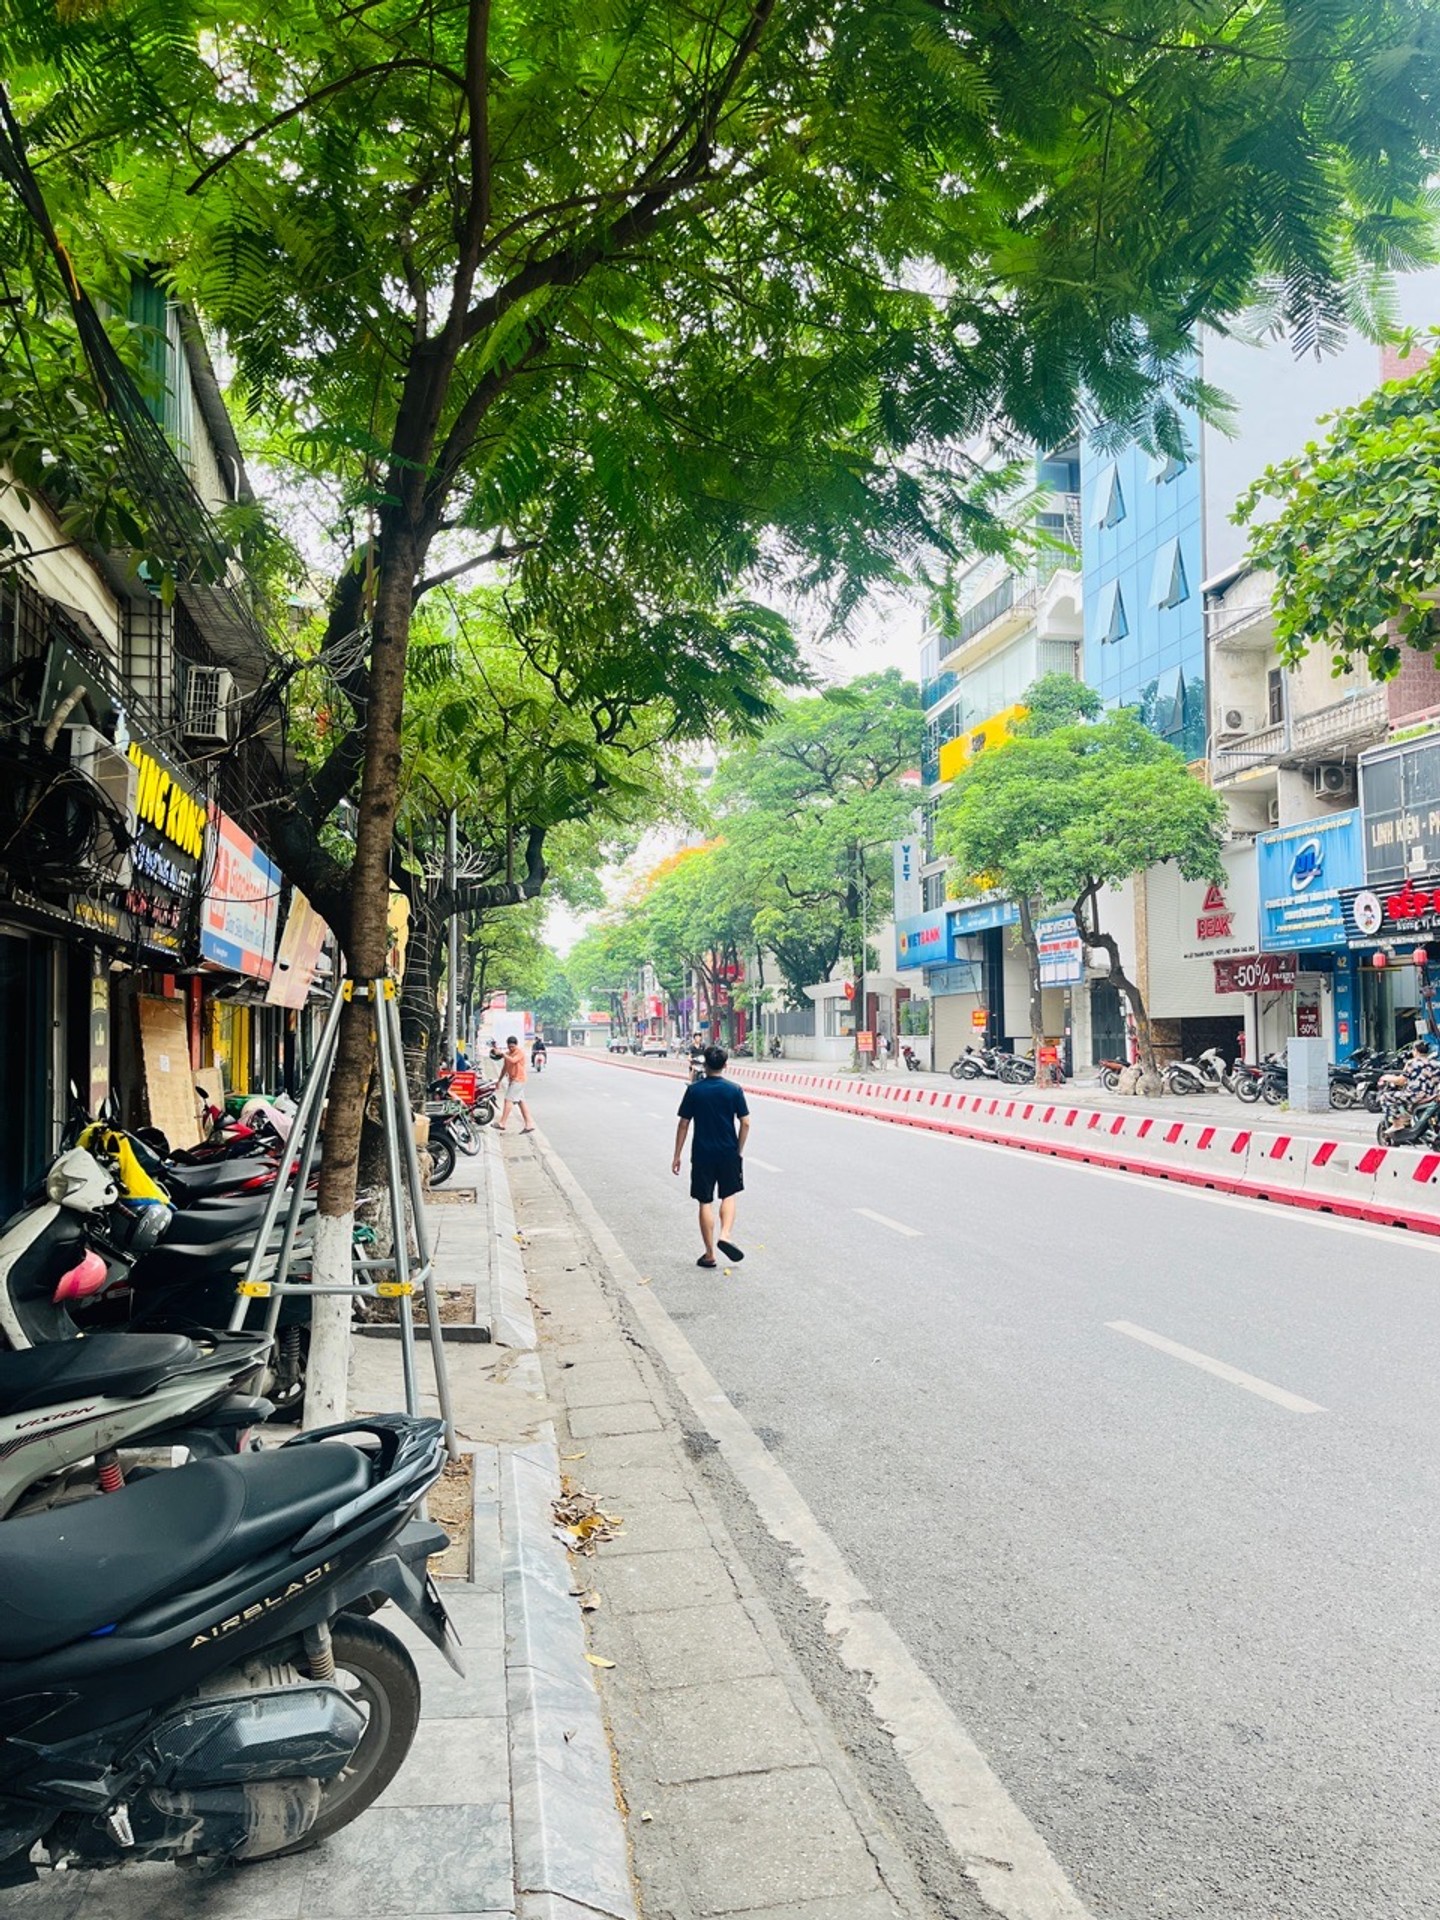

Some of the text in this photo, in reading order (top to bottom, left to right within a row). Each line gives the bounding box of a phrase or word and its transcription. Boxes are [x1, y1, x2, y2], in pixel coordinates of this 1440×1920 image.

[165, 782, 207, 859] KONG
[901, 844, 911, 881] VIET
[907, 926, 940, 949] VIETBANK
[1197, 914, 1232, 940] PEAK
[1233, 963, 1270, 987] -50%
[15, 1404, 96, 1430] VISION
